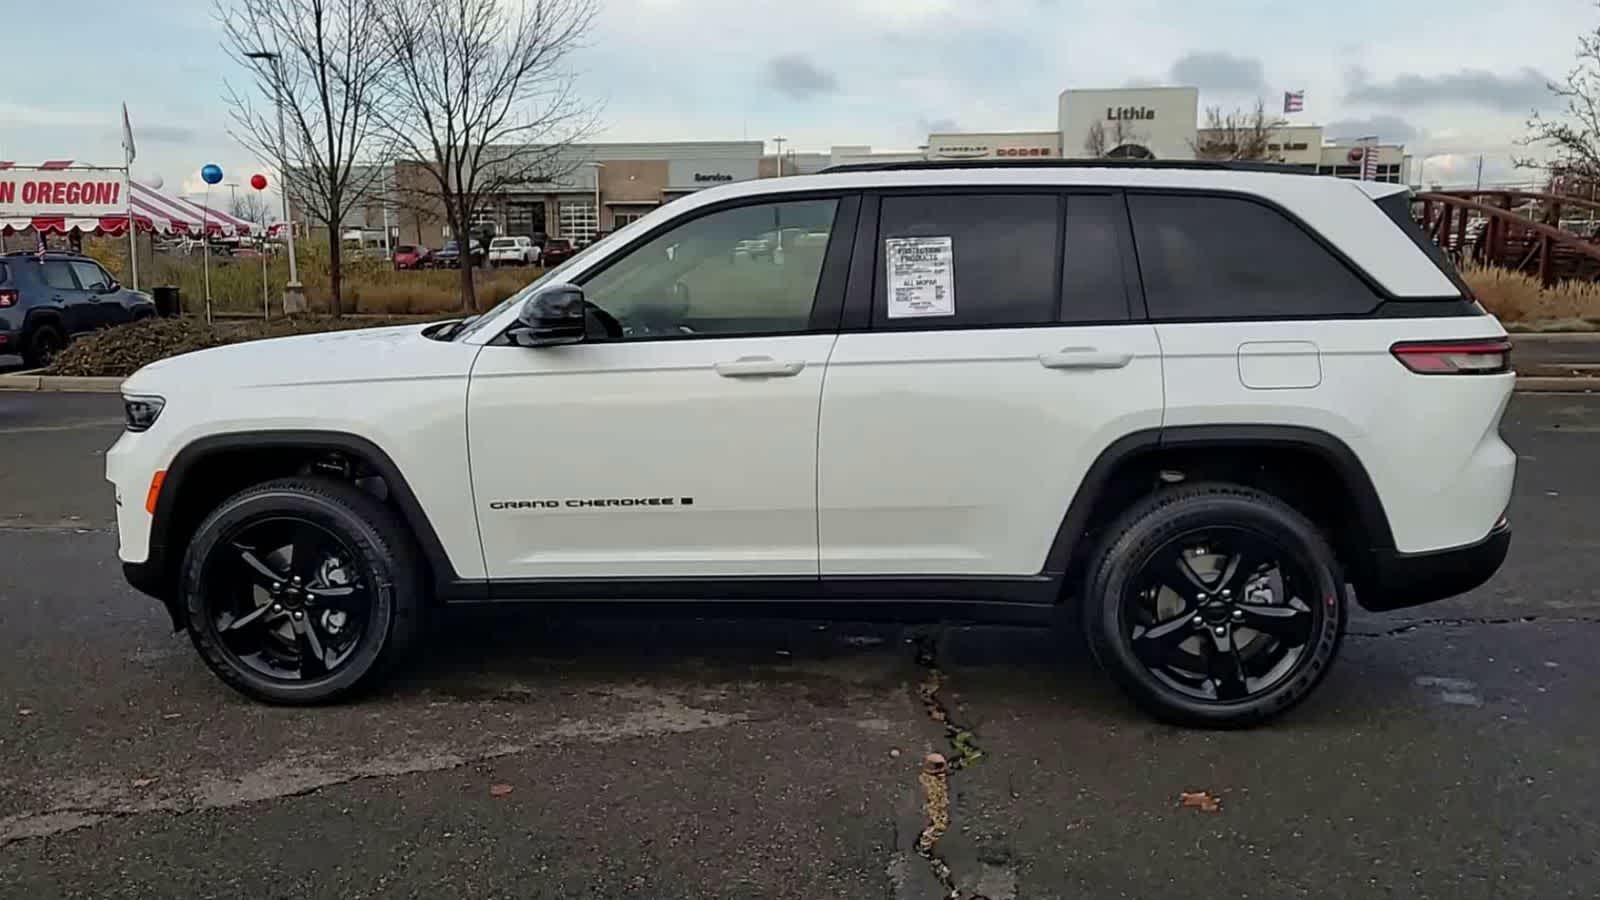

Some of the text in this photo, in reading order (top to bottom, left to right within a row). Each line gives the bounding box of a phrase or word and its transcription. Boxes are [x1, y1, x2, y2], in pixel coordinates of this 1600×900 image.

[1107, 106, 1155, 121] Lithia
[996, 147, 1051, 157] DODGE
[694, 172, 733, 181] Service
[22, 181, 120, 205] OREGON!
[489, 497, 674, 510] GRAND CHEROKEE
